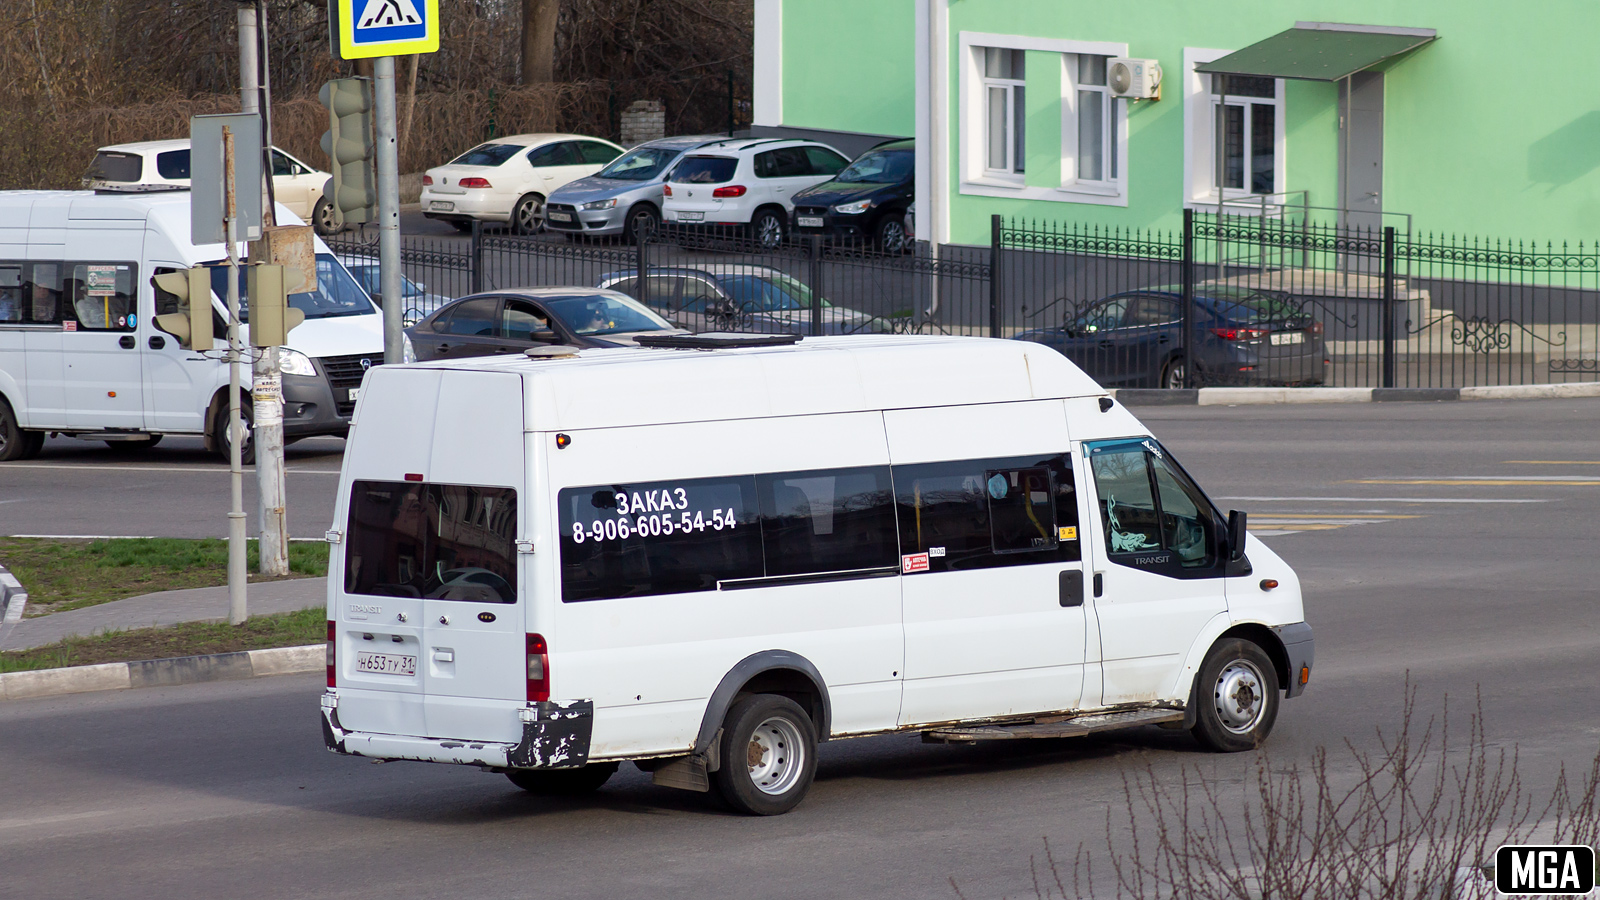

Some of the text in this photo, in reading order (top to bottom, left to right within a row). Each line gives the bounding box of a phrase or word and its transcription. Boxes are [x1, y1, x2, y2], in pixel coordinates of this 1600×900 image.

[615, 487, 688, 515] ЗАКАЗ
[572, 507, 737, 544] 8-906-605-54-54
[1135, 555, 1170, 565] TRANSIT
[349, 604, 383, 614] TRANSIT
[401, 657, 412, 669] 31
